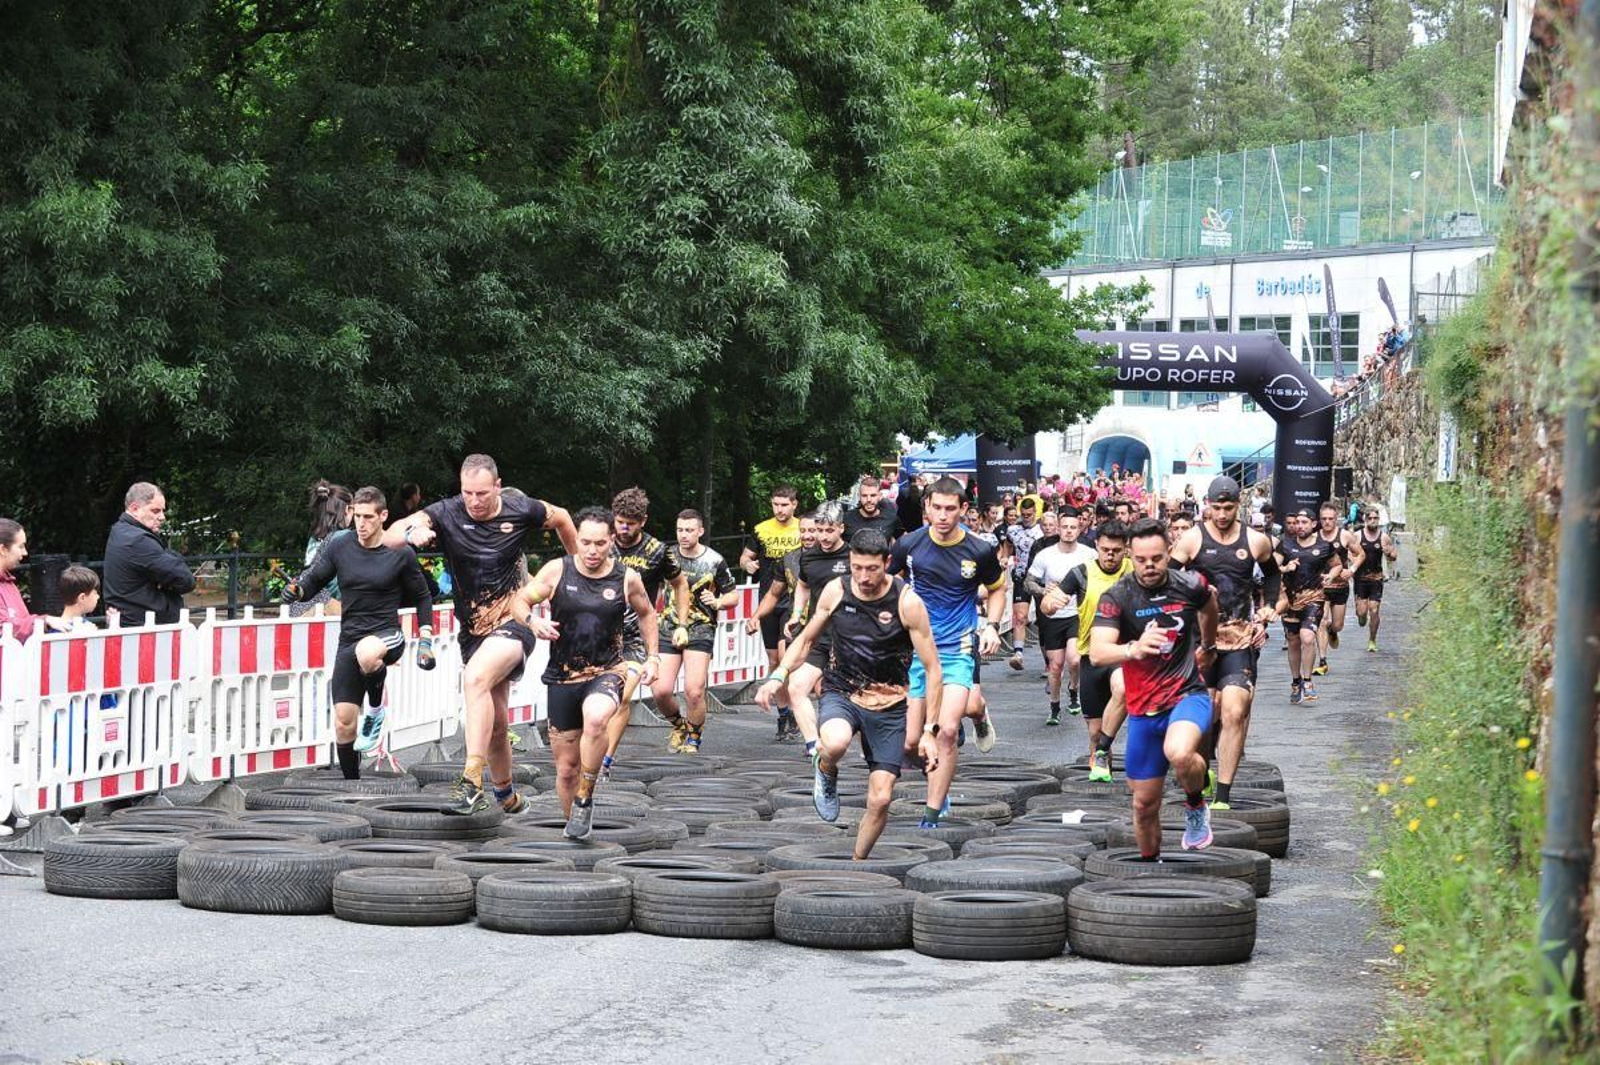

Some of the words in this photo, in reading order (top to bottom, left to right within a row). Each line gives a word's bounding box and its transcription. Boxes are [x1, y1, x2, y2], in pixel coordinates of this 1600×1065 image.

[1256, 273, 1321, 296] Barbadás
[1108, 342, 1238, 363] ISSAN
[1114, 366, 1162, 382] UPO
[1167, 368, 1236, 384] ROFER
[1264, 388, 1309, 397] NISSAN
